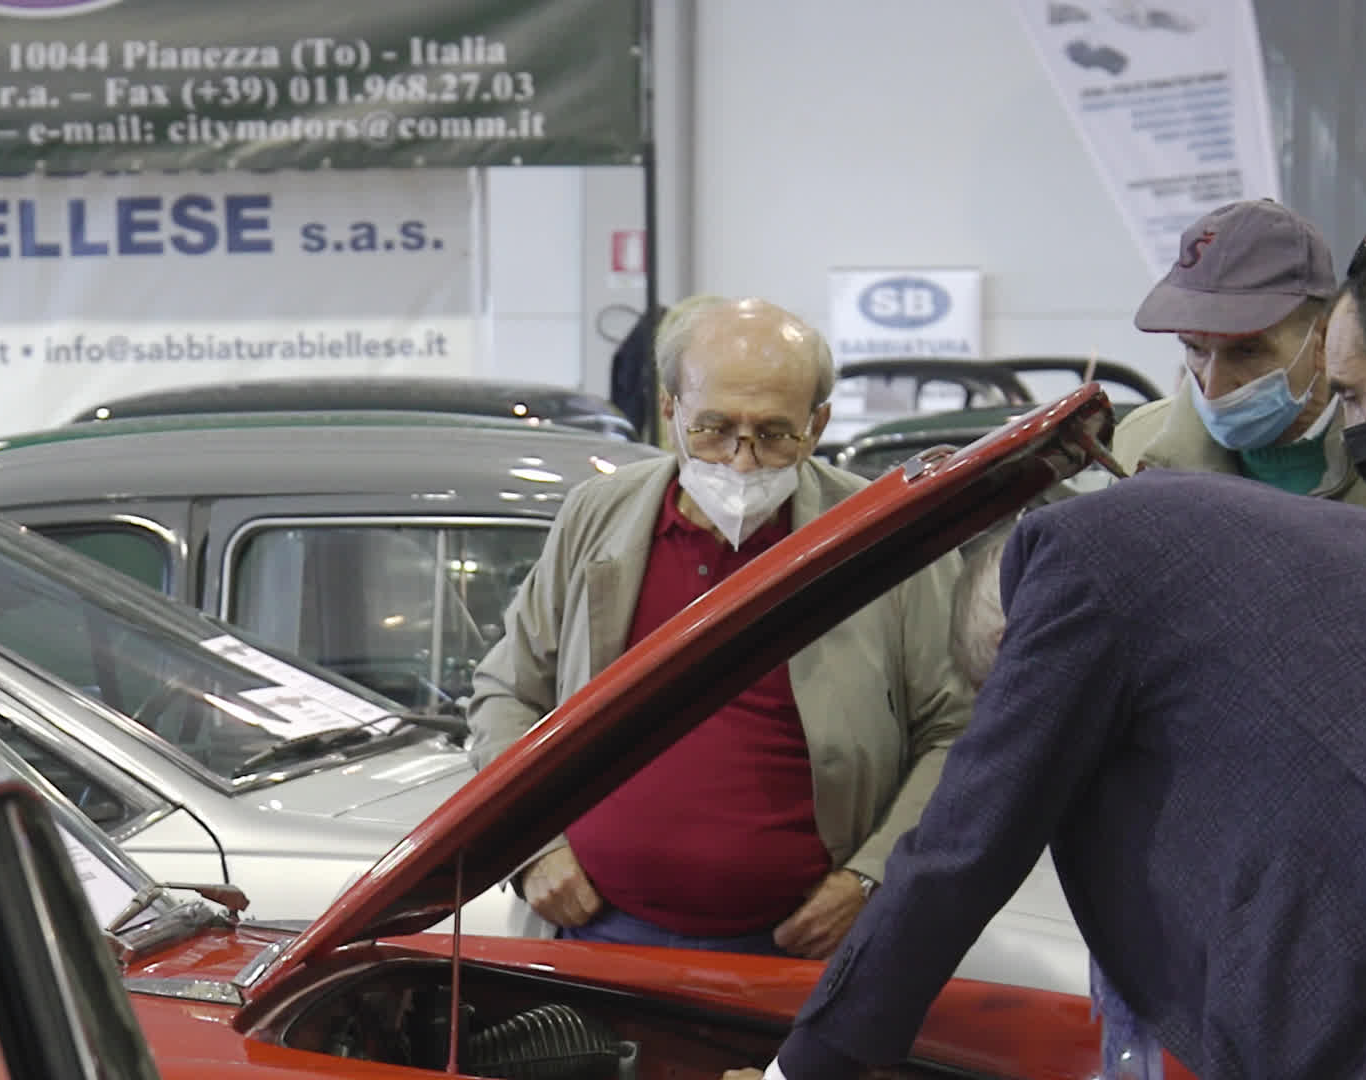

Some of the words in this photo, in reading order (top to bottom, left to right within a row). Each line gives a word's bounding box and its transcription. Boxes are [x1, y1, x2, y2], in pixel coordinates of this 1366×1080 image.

[10, 41, 108, 70] 10044
[124, 39, 280, 68] Pianezza
[291, 38, 371, 70] (To)
[410, 36, 506, 65] Italia
[0, 86, 59, 108] r.a.
[106, 77, 170, 105] Fax
[182, 76, 277, 108] (+39)
[290, 73, 534, 103] 011.968.27.03
[29, 115, 155, 143] e-mail:
[168, 112, 545, 148] citymotors@comm.it
[300, 220, 445, 253] s.a.s.
[869, 285, 936, 318] SB
[45, 332, 446, 364] info@sabbiaturabiellese.it
